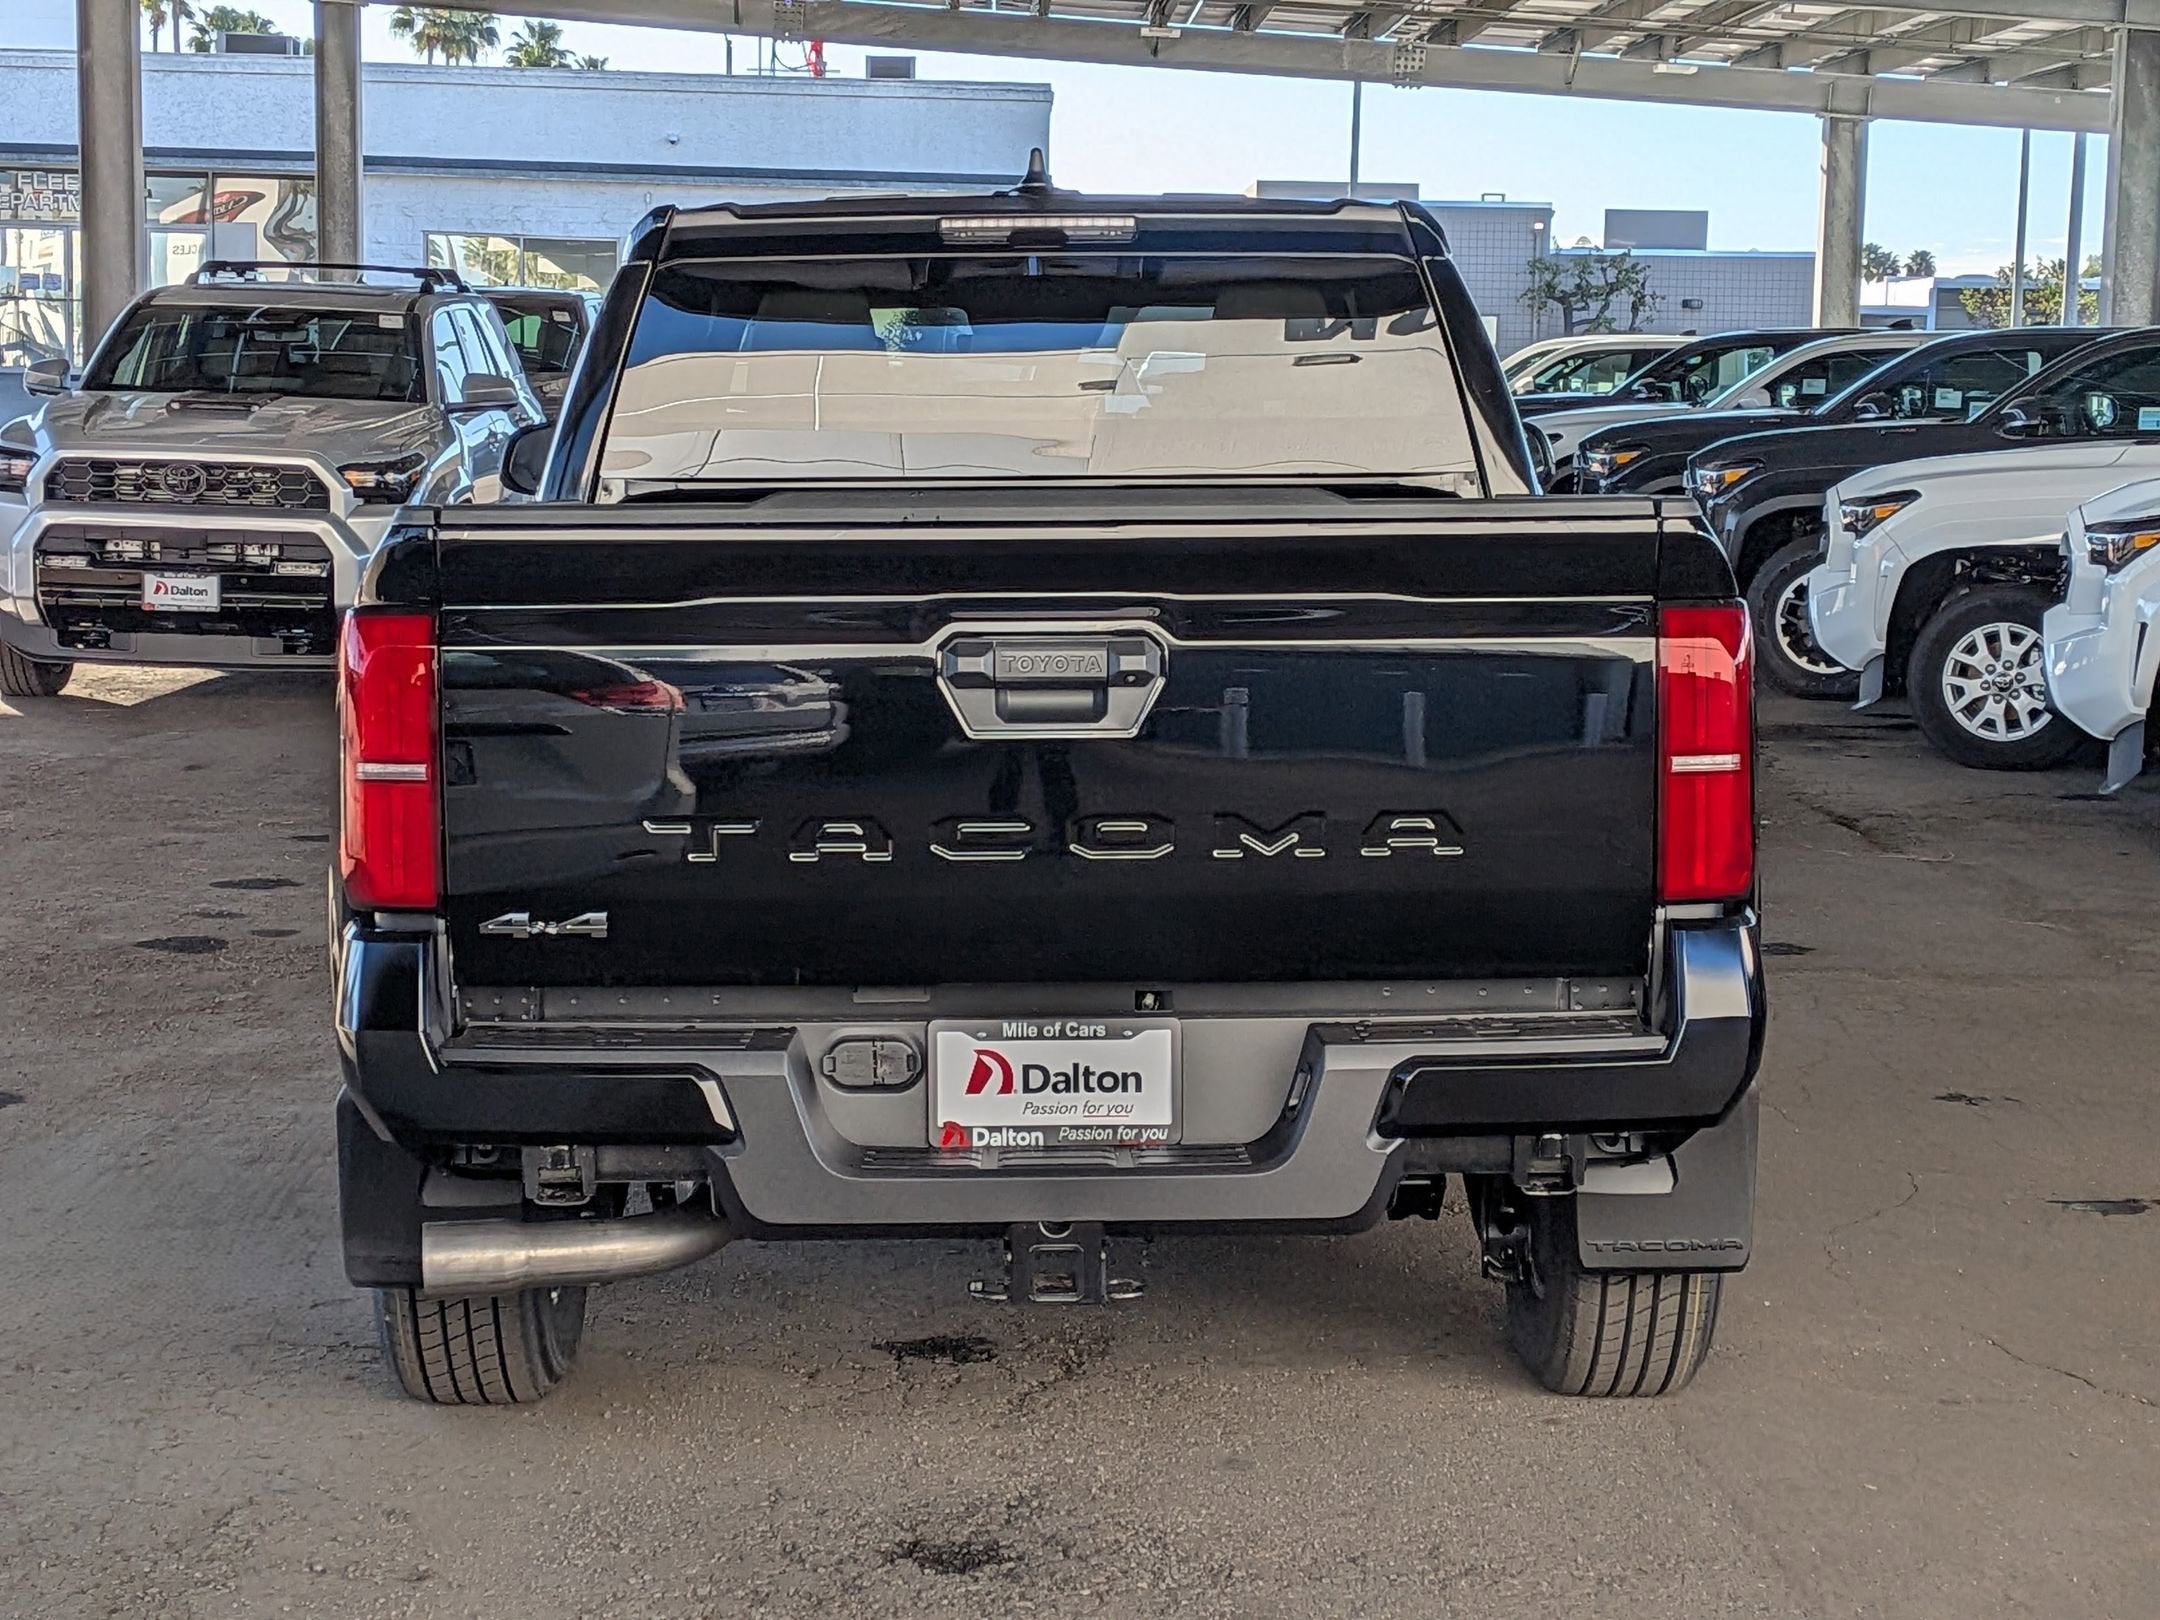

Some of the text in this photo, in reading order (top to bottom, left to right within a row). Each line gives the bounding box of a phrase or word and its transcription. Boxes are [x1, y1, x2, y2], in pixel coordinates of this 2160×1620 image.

[170, 585, 209, 597] Dalton
[1000, 654, 1103, 674] TOYOTA
[642, 811, 1465, 862] TACOMA
[1002, 1021, 1107, 1038] Mile of Cars
[1022, 1062, 1143, 1094] Dalton
[1022, 1099, 1134, 1117] Passion for you
[972, 1127, 1045, 1148] Dalton
[1058, 1125, 1169, 1144] Passion for you
[1585, 1237, 1744, 1253] TACOMA
